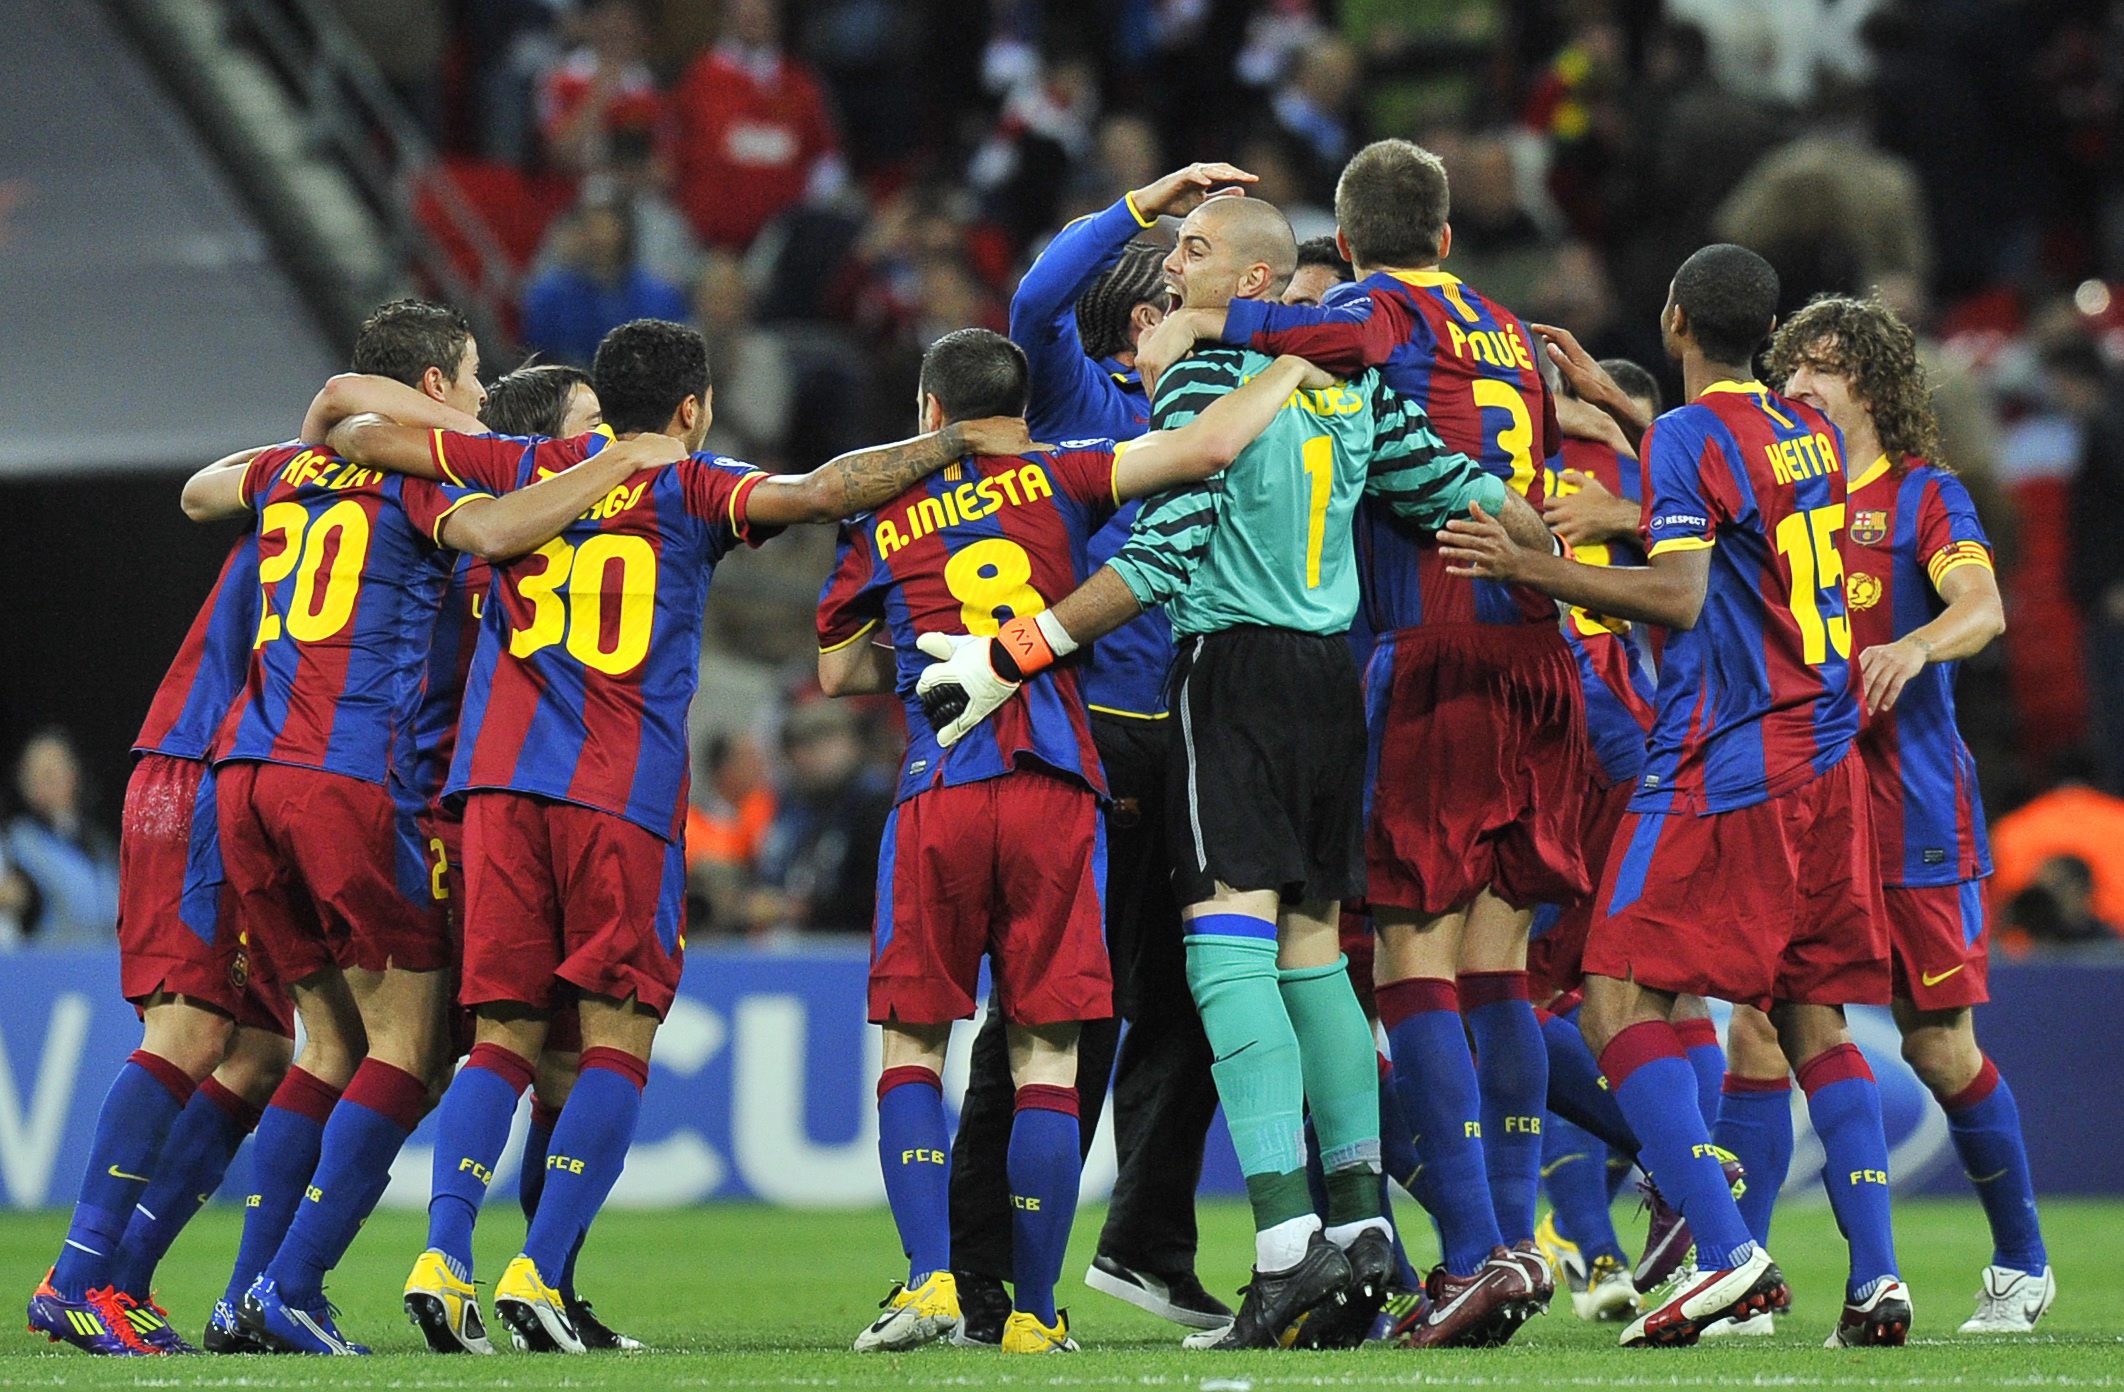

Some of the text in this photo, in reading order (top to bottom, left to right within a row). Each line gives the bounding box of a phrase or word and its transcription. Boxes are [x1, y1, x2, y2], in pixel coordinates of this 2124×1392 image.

[1472, 378, 1536, 497] 3
[1764, 432, 1839, 486] KEITA
[874, 464, 1053, 560] A.INIESTA
[1302, 434, 1333, 589] 1
[1665, 514, 1707, 527] RESPECT
[253, 499, 369, 649] 20
[944, 538, 1046, 637] 8
[1776, 502, 1851, 665] 15
[509, 533, 656, 675] 30
[1505, 1116, 1541, 1135] FCB
[546, 1155, 585, 1175] FCB
[902, 1148, 945, 1165] FCB
[1692, 1144, 1715, 1159] FC
[305, 1184, 323, 1203] CB
[1850, 1169, 1887, 1185] FCB
[245, 1194, 262, 1208] CB
